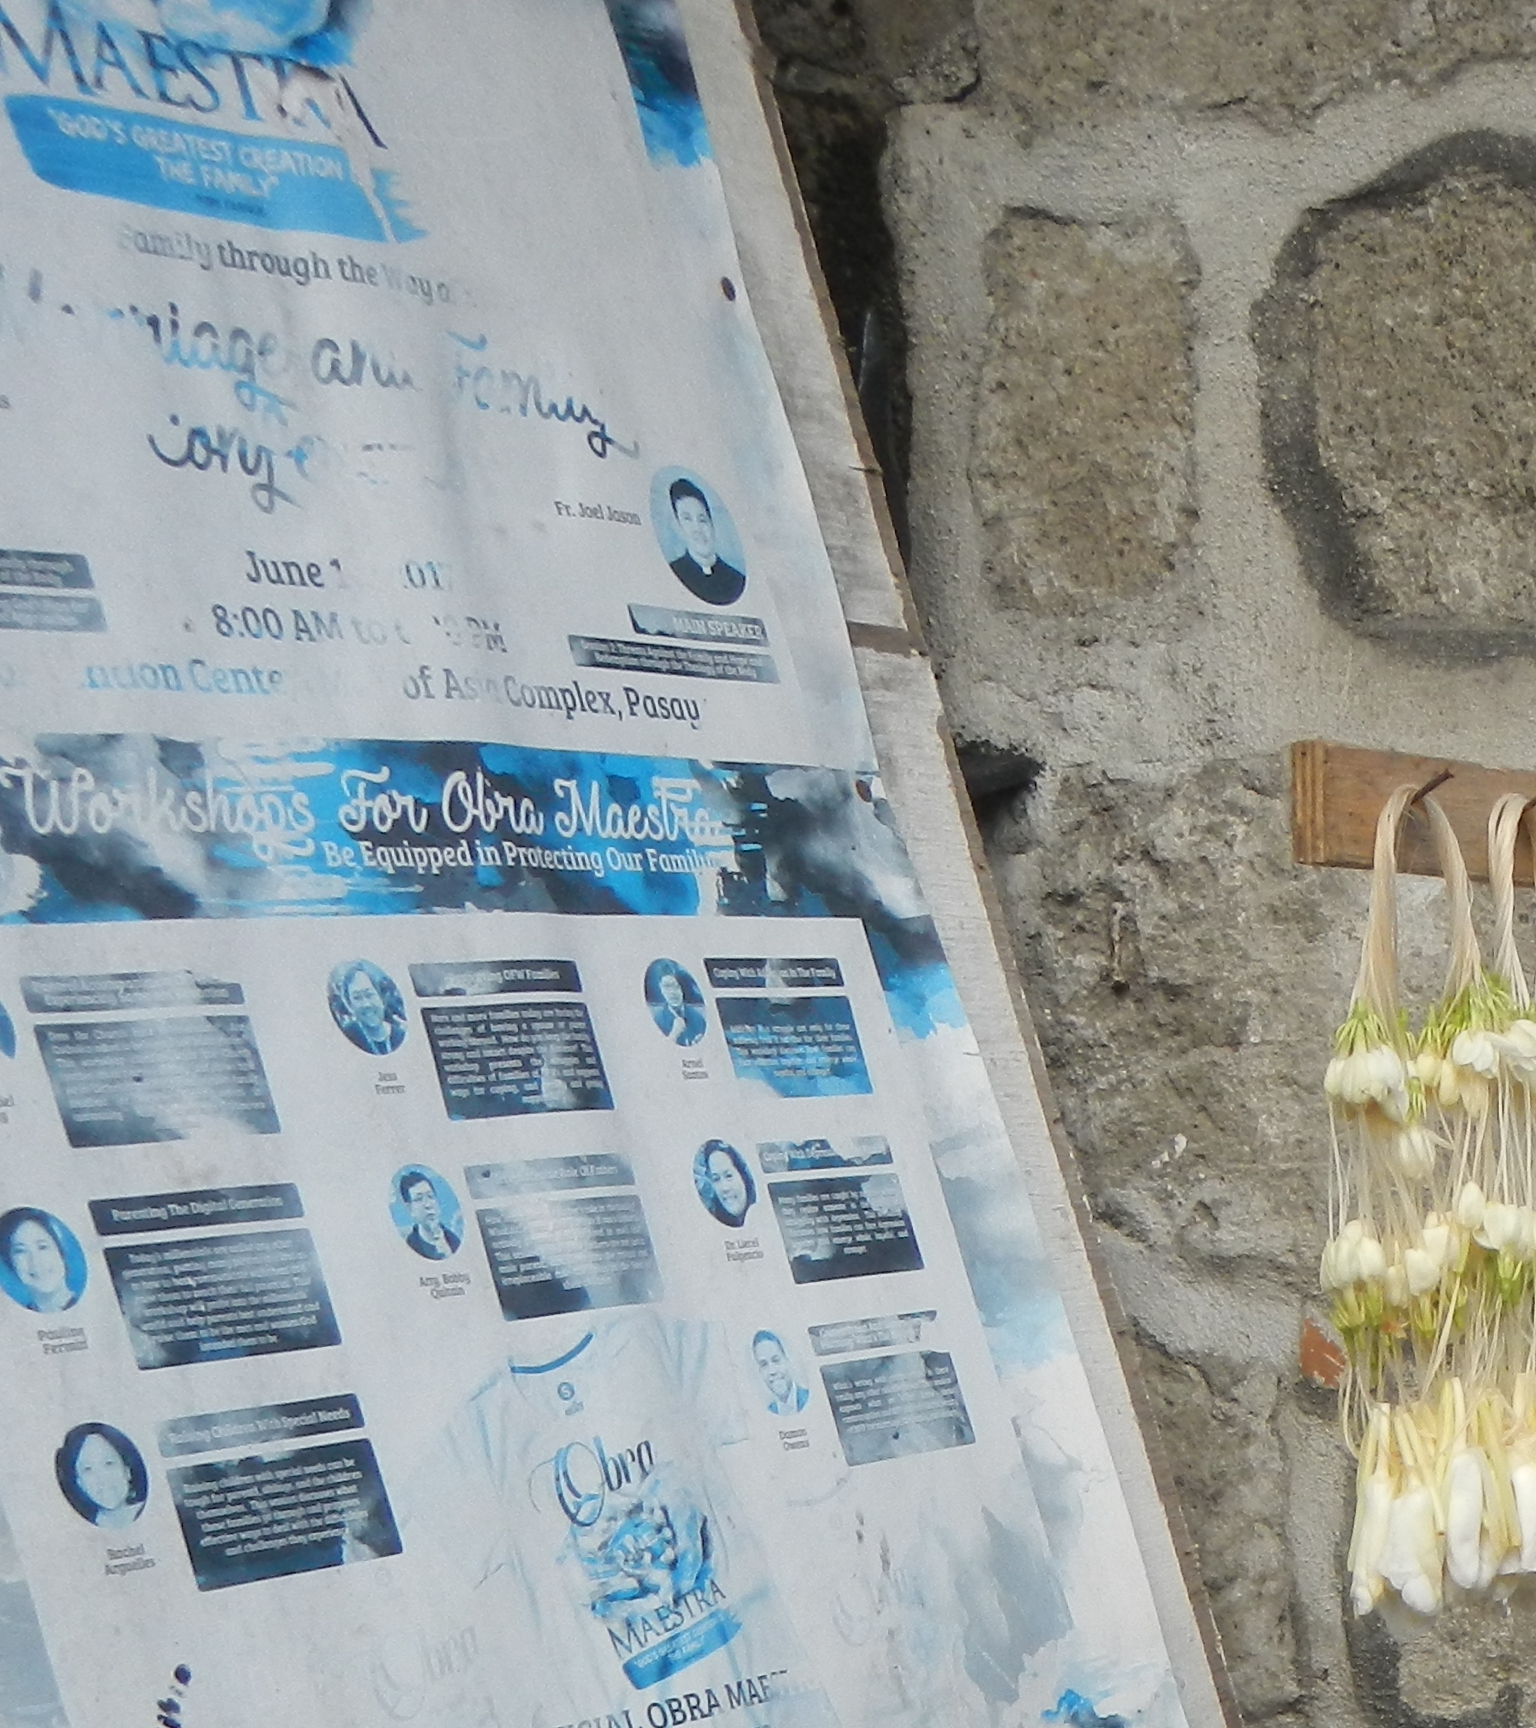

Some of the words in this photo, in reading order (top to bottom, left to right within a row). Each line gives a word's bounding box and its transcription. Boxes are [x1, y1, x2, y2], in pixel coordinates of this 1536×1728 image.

[217, 239, 330, 285] through
[337, 255, 378, 287] the
[554, 501, 574, 518] Fr.
[246, 550, 326, 589] June
[212, 603, 284, 641] 8:00
[291, 609, 344, 643] AM
[708, 620, 764, 640] SPEAKER
[505, 674, 624, 722] Complex,
[625, 686, 701, 731] Pasay
[0, 763, 317, 862] Workshops
[338, 766, 428, 835] For
[443, 766, 545, 836] Obra
[321, 840, 357, 868] Be
[358, 840, 474, 876] Equipped
[477, 839, 501, 867] in
[503, 841, 605, 877] Protecting
[605, 846, 643, 872] Our
